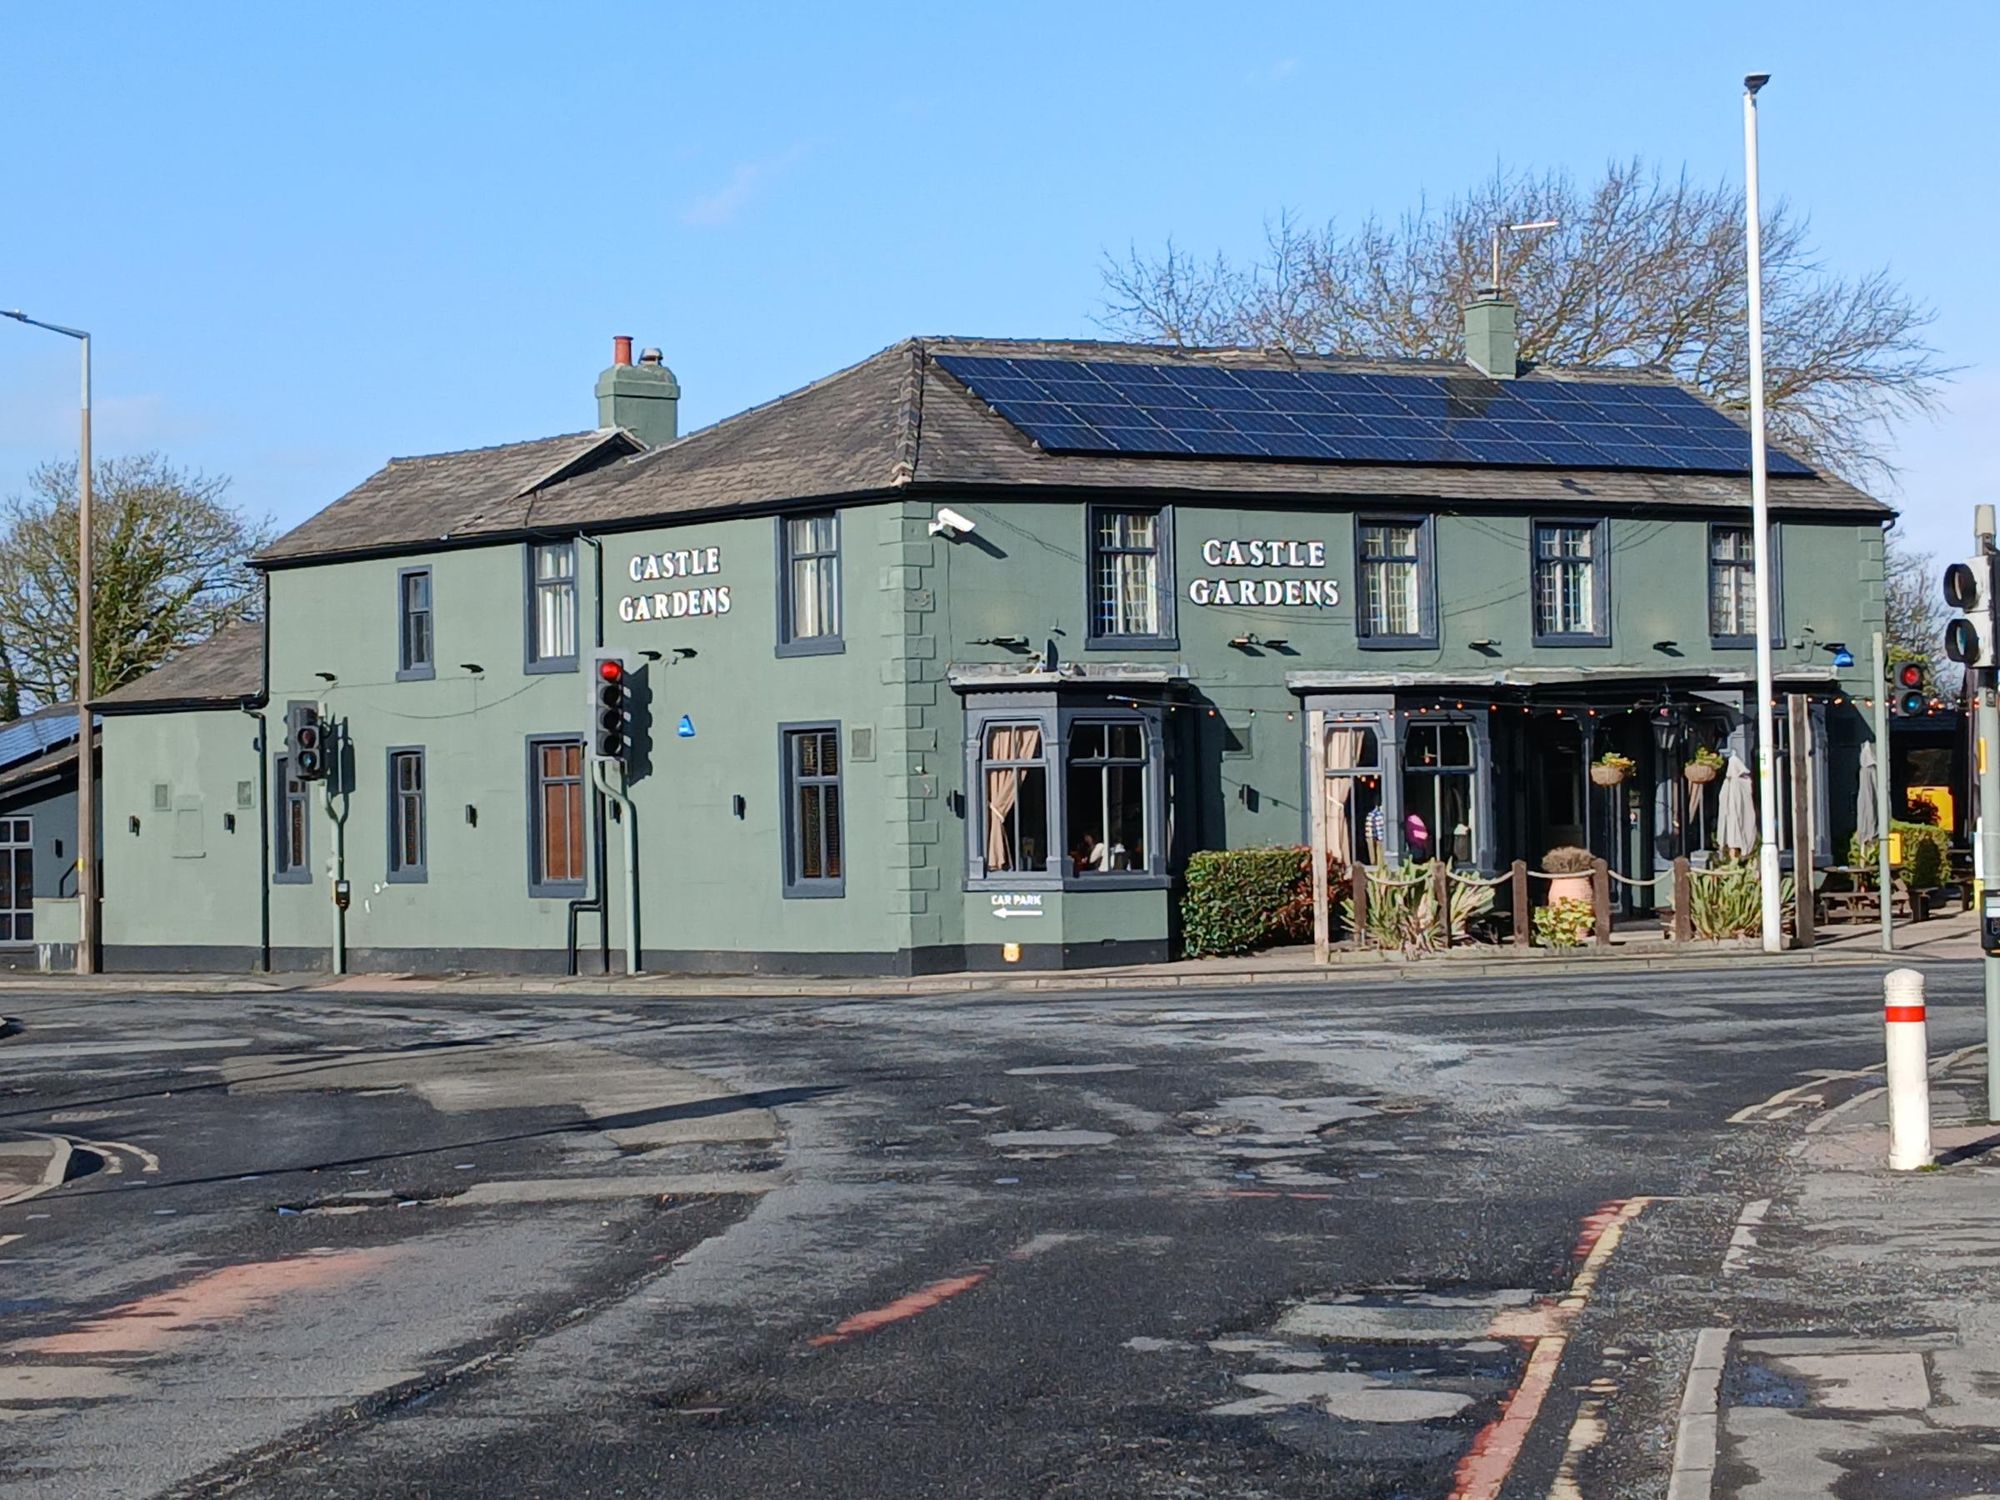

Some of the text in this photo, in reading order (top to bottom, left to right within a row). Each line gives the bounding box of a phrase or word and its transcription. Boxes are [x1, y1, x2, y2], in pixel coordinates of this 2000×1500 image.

[629, 547, 719, 581] CASTLE
[1202, 539, 1326, 568] CASTLE
[618, 587, 730, 622] GARDENS
[1189, 579, 1340, 607] GARDENS
[991, 894, 1042, 906] CAR PARK
